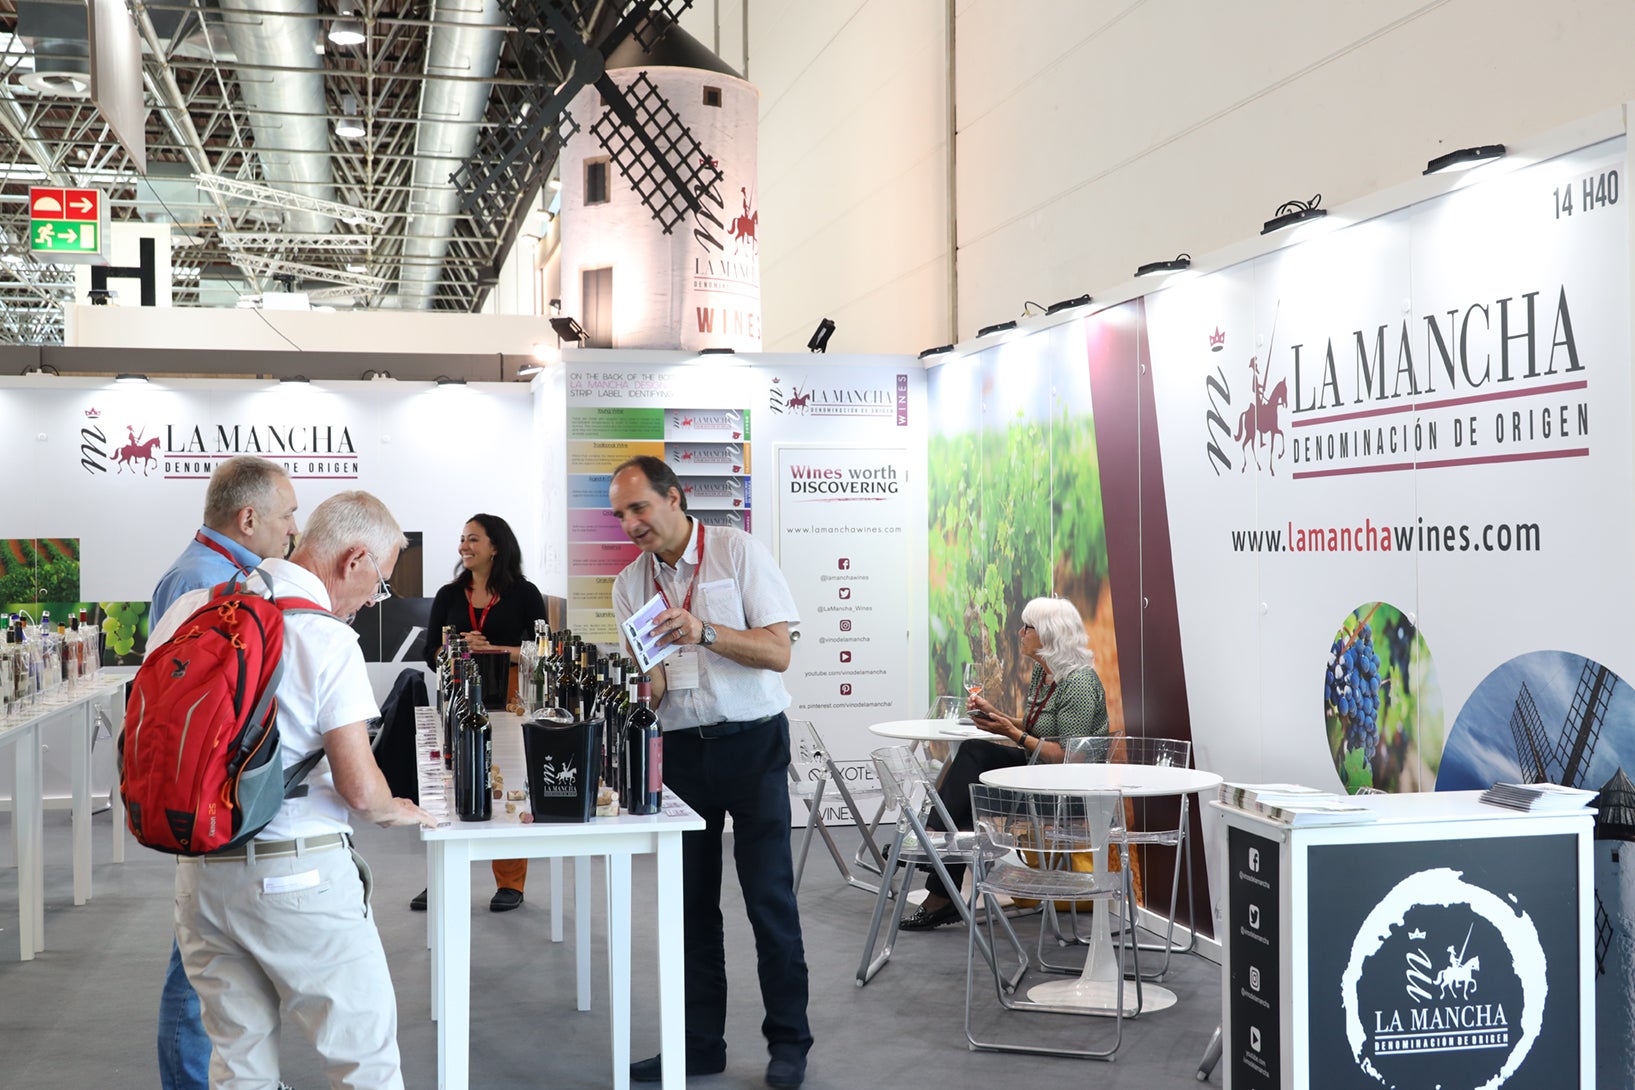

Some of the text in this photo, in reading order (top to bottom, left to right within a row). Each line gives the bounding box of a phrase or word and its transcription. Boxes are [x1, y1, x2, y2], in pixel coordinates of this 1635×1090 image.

[1553, 169, 1619, 219] 14 H40
[91, 238, 156, 306] H
[694, 257, 714, 277] LA
[1291, 283, 1586, 414] LA MANCHA
[570, 372, 582, 380] ON
[588, 381, 629, 389] MANCHA
[570, 389, 675, 398] STRIP LABEL IDENTIFYING
[812, 389, 892, 404] LA MANCHA
[898, 376, 907, 425] WINES
[164, 424, 357, 453] LA MANCHA
[1293, 403, 1589, 464] DENOMINACIÓN DE ORIGEN
[308, 462, 359, 473] ORIGEN
[790, 464, 897, 480] Wines worth
[790, 481, 899, 494] DISCOVERING
[786, 525, 903, 535] www.lamanchawines.com
[1231, 517, 1541, 552] www.lamanchawines.com
[820, 574, 869, 582] @lamanchawines
[817, 605, 873, 613] @LaMancha_Wines
[819, 636, 871, 644] @vinodelamancha
[208, 802, 216, 815] 25
[1375, 1003, 1508, 1033] LA MANCHA
[1375, 1033, 1508, 1051] DENOMINACIÓN DE ORIGEN
